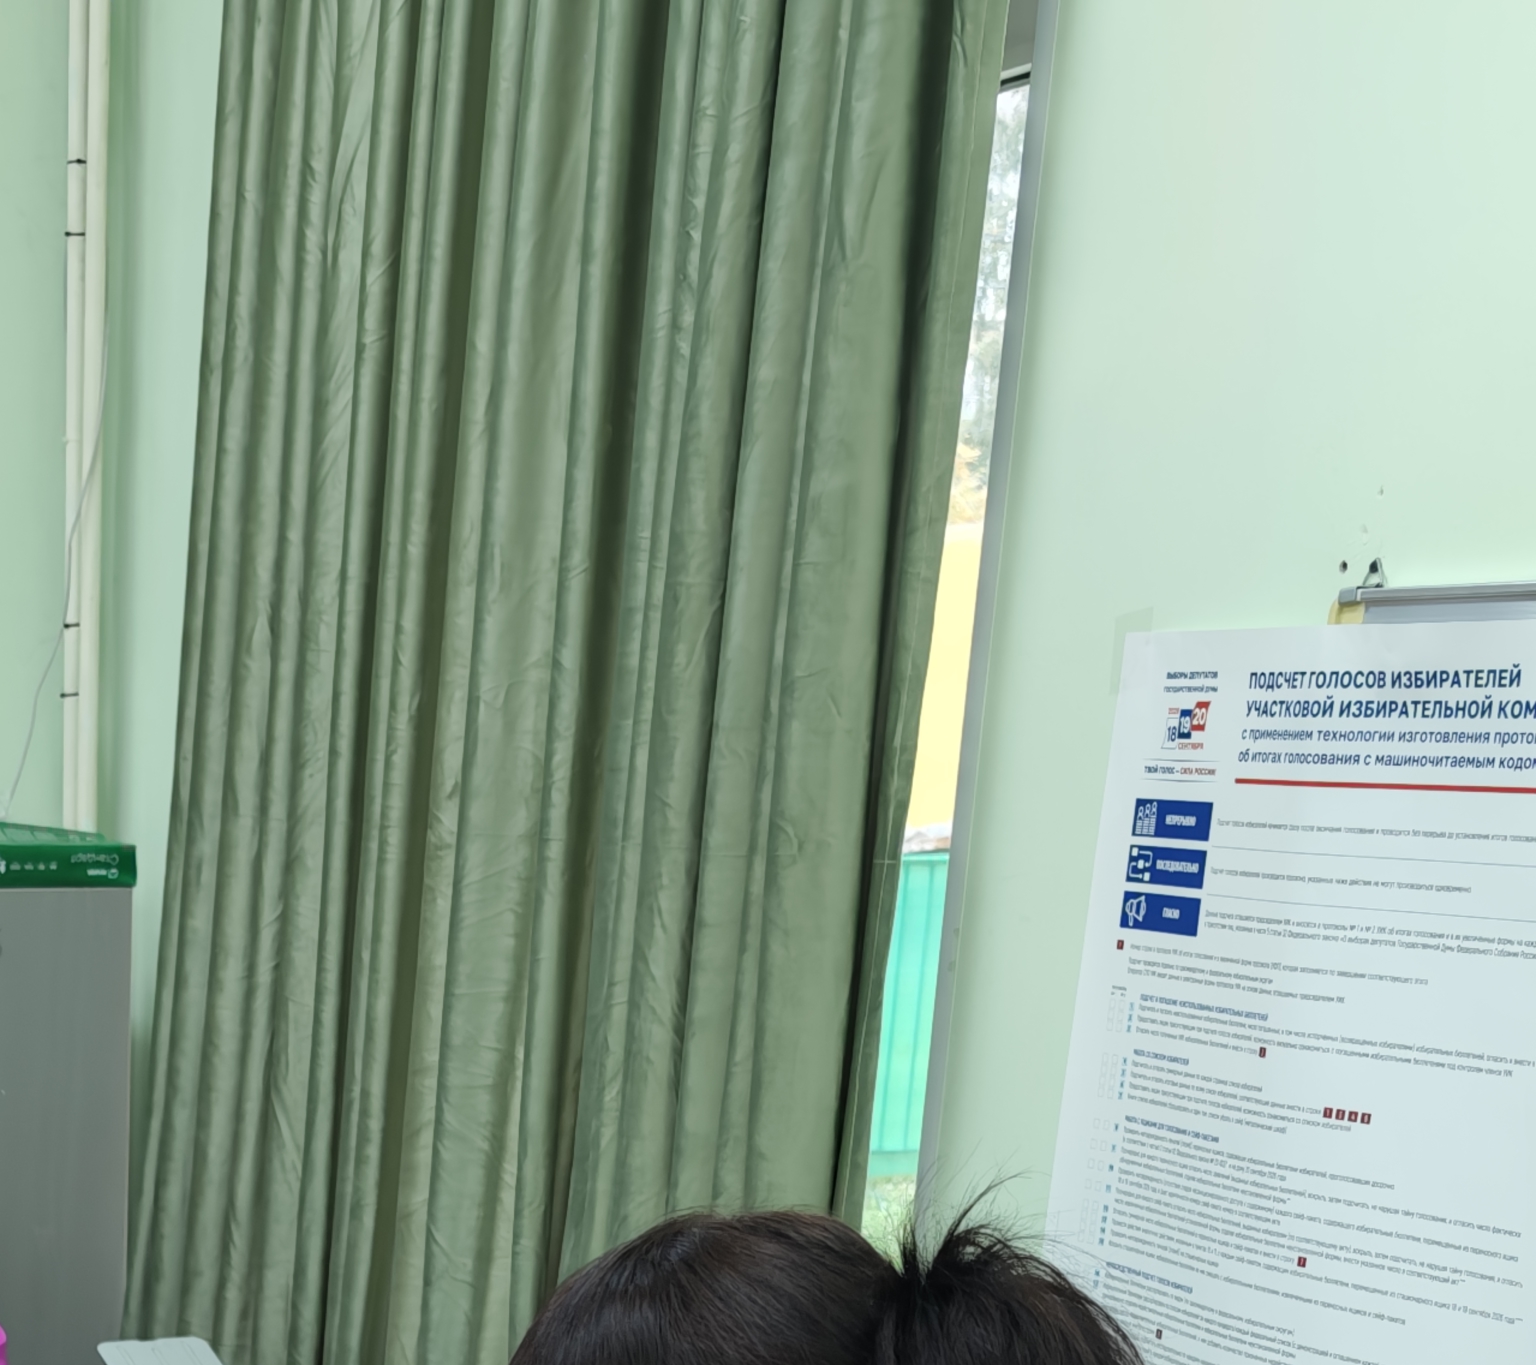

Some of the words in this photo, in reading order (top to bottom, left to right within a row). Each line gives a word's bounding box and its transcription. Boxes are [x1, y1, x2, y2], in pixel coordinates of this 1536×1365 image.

[1249, 671, 1307, 692] ПОДСЧЕТ
[1307, 670, 1386, 689] ГОЛОСОВ
[1390, 663, 1522, 689] ИЗБИРАТЕЛЕЙ
[1192, 707, 1207, 725] 20
[1246, 695, 1334, 718] УЧАСТКОВОЙ
[1338, 695, 1493, 719] ИЗБИРАТЕЛЬНОЙ
[1167, 725, 1177, 742] 18
[1180, 716, 1191, 733] 19
[1241, 729, 1247, 740] с
[1249, 729, 1313, 743] применением
[1317, 729, 1395, 742] технологии
[1398, 731, 1490, 744] изготовления
[1493, 732, 1536, 748] прото
[1238, 748, 1250, 762] об
[1251, 751, 1282, 764] итогах
[1284, 752, 1361, 765] голосования
[1363, 754, 1372, 766] с
[1374, 754, 1495, 769] машиночитаемым
